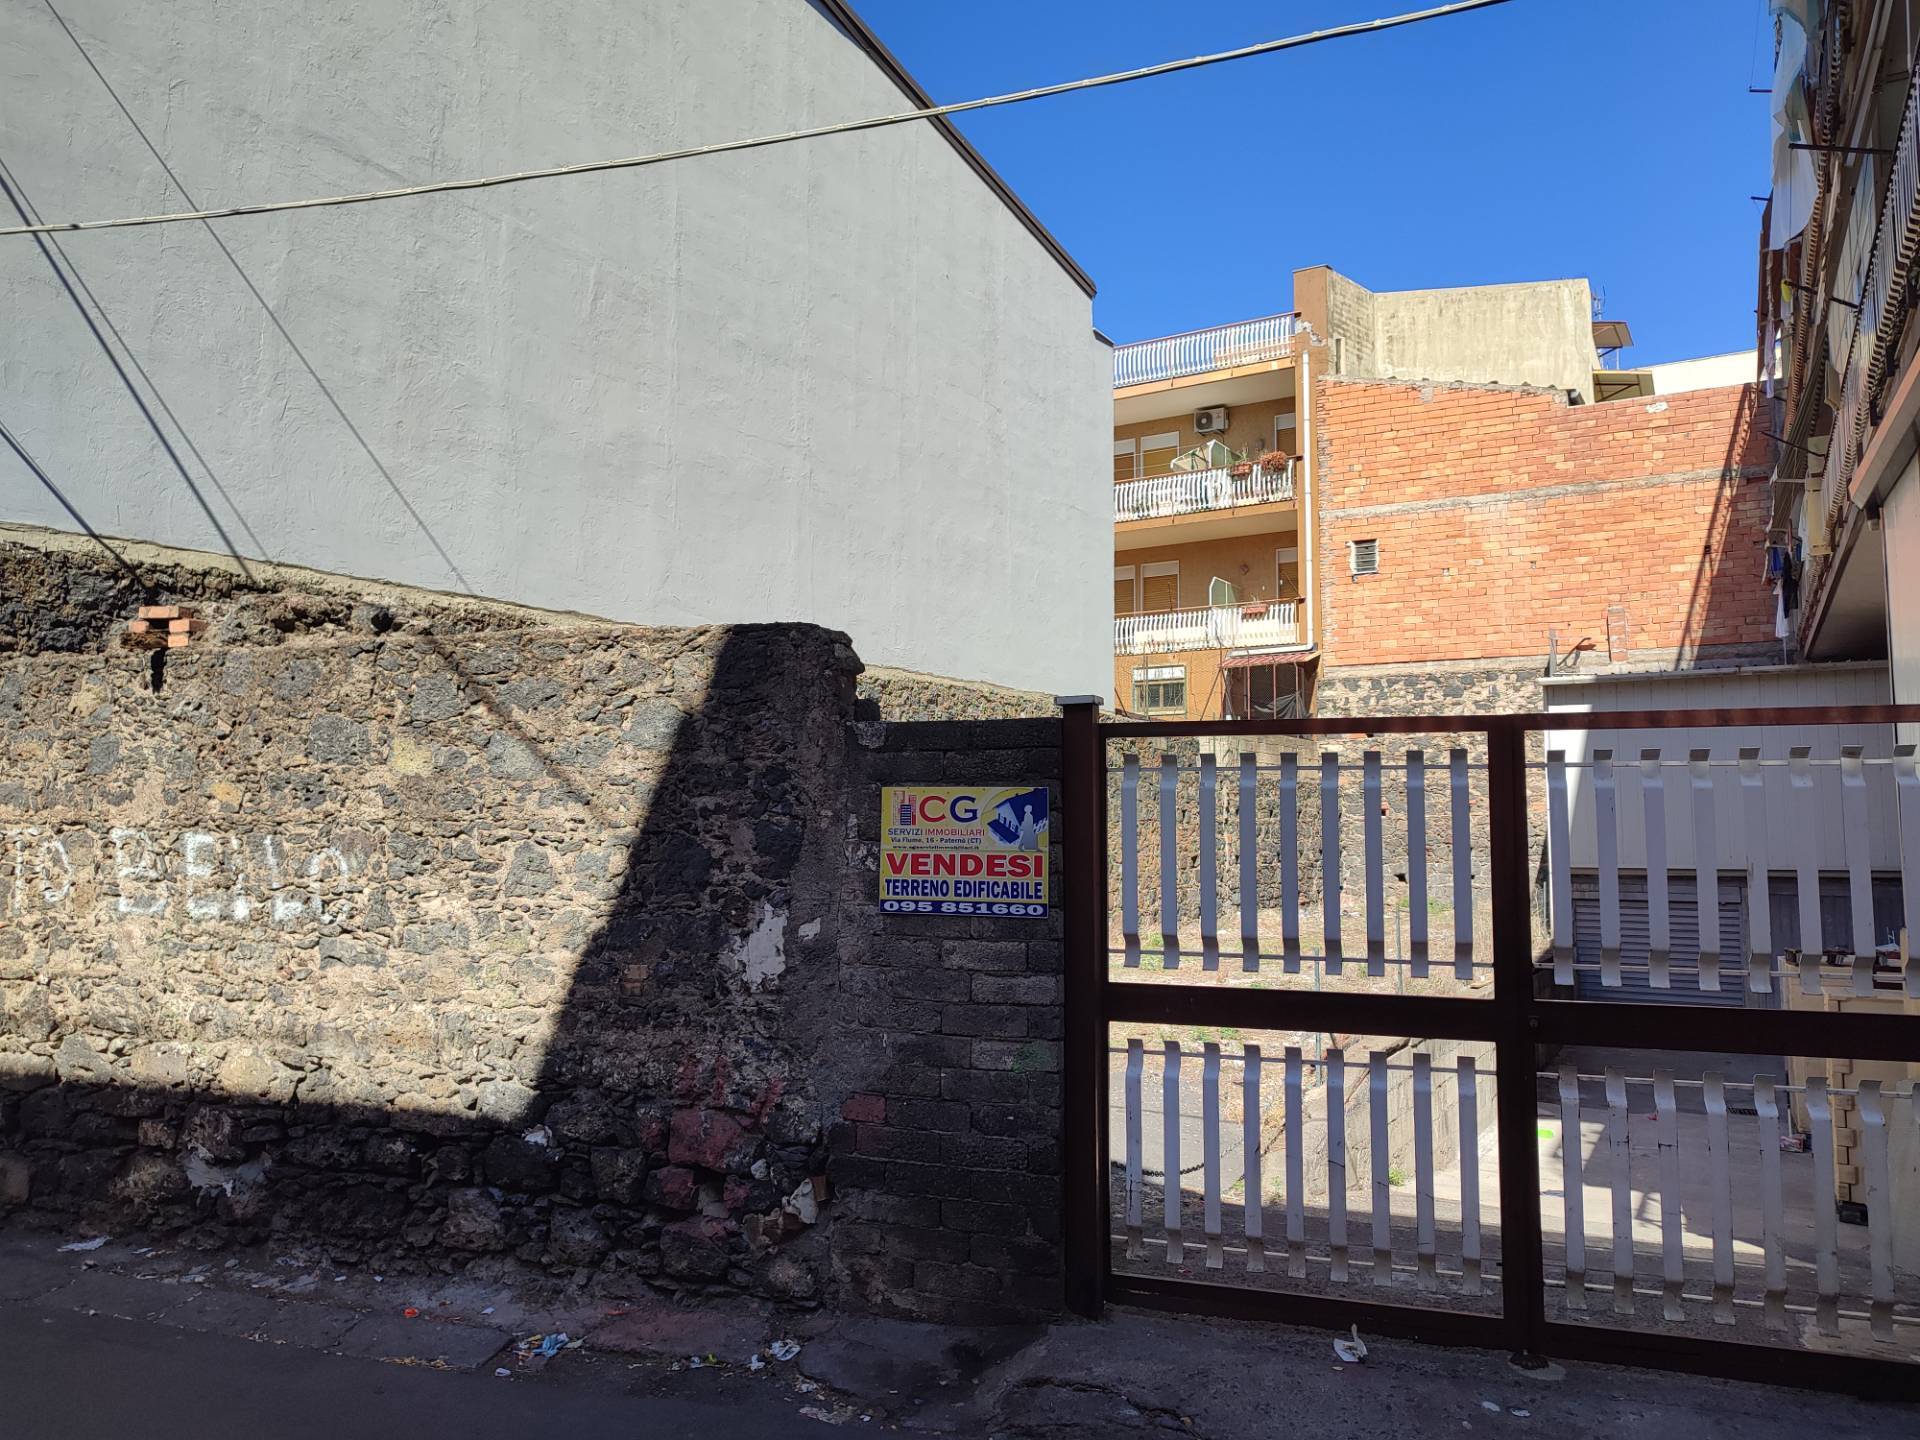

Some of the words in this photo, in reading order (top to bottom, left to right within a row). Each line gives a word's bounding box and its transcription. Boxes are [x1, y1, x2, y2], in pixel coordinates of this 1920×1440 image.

[886, 853, 1043, 877] VENDESI
[885, 879, 949, 897] TERRENO
[954, 880, 1042, 899] EDIFICABILE
[883, 901, 933, 911] 095
[941, 902, 1043, 916] 851660
